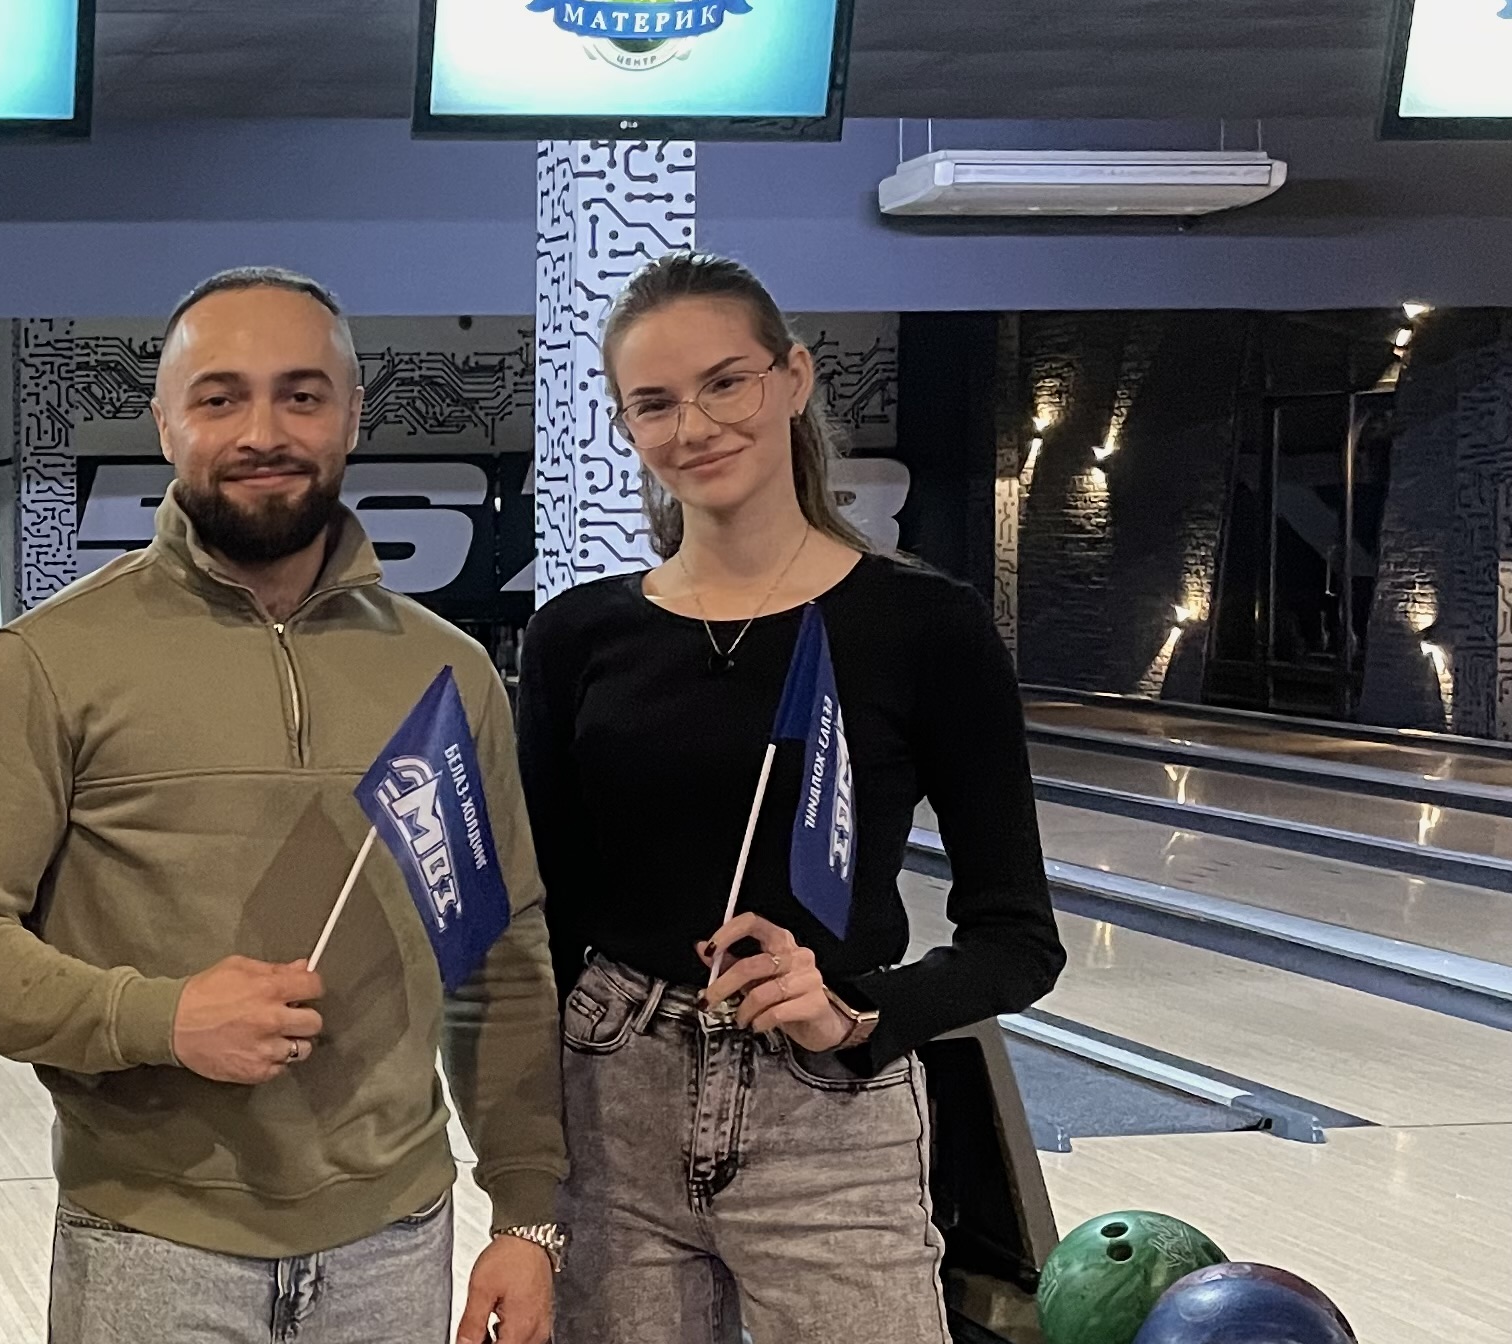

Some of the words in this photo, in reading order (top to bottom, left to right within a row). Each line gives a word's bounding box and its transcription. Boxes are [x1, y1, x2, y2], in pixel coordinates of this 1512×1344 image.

[562, 2, 718, 33] МАТЕРИК
[615, 54, 657, 67] ЦЕНТР
[444, 742, 489, 871] БЕЛАЗ-ХОЛДИНГ
